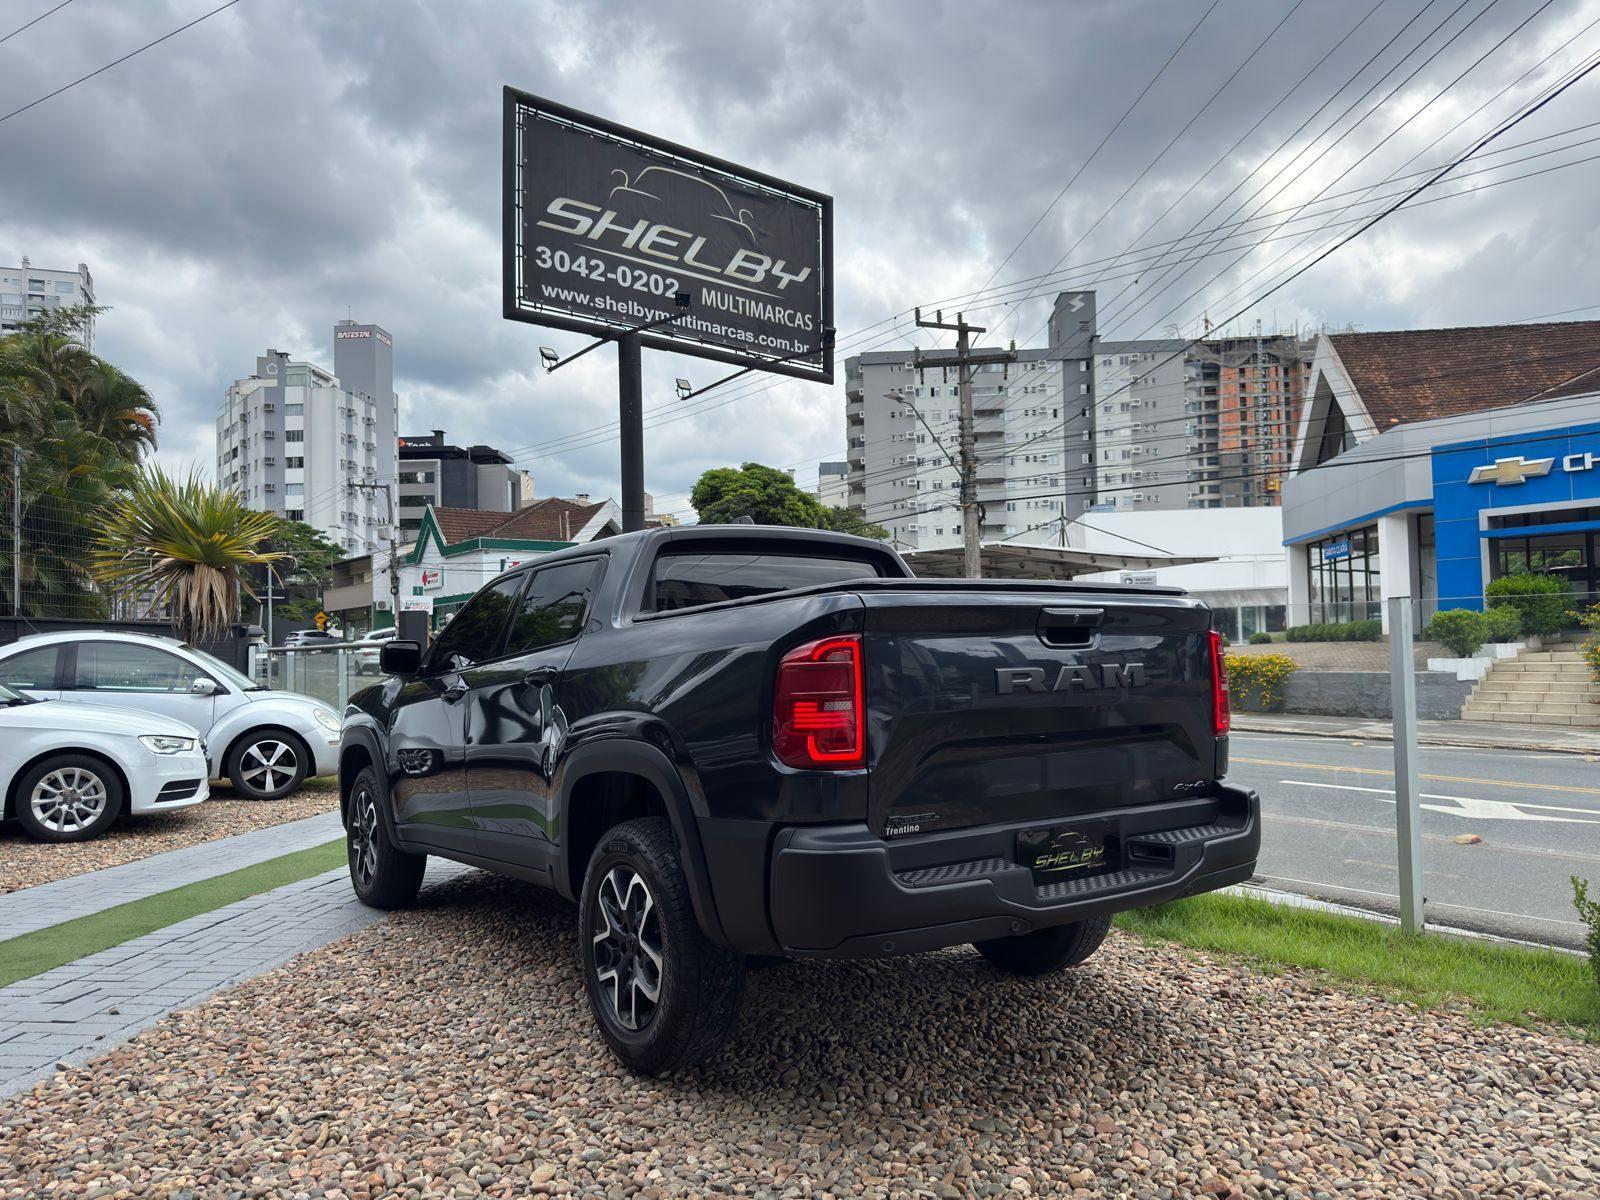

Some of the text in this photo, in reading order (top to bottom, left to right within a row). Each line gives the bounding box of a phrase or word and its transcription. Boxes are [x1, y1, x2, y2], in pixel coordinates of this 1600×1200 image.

[536, 198, 811, 290] SHELBY
[535, 246, 680, 299] 3042-0202
[702, 288, 812, 331] MULTIMARCAS
[995, 663, 1144, 694] RAM
[886, 824, 920, 836] Trentino
[1033, 846, 1104, 869] SHELBY
